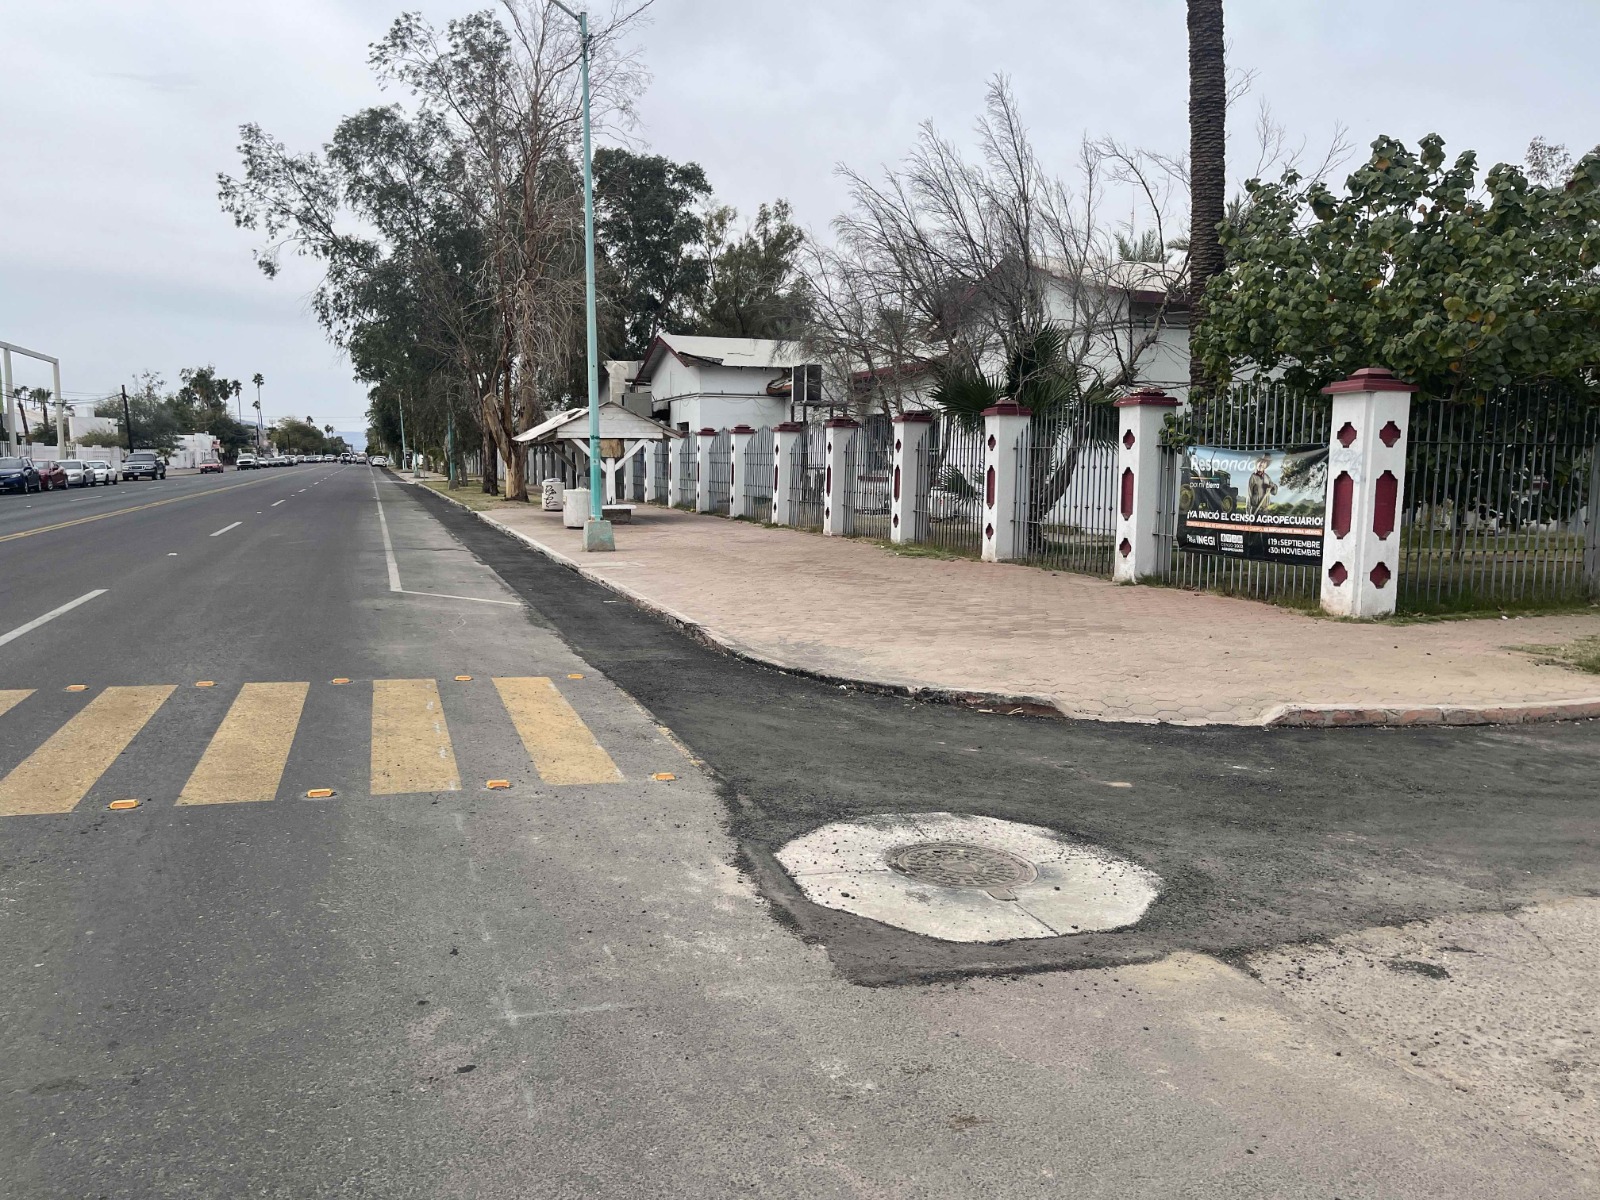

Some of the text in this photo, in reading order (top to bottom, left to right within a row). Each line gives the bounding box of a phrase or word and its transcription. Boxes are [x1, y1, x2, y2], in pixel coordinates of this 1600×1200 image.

[1187, 510, 1198, 519] ¡YA
[1199, 510, 1220, 520] INICIÓ
[1221, 513, 1230, 521] EL
[1230, 513, 1255, 522] CENSO
[1256, 514, 1324, 526] AGROPECUARIO!
[1196, 535, 1216, 546] INEGI
[1280, 539, 1321, 549] SEPTIEMBRE
[1281, 547, 1321, 557] NOVIEMBRE
